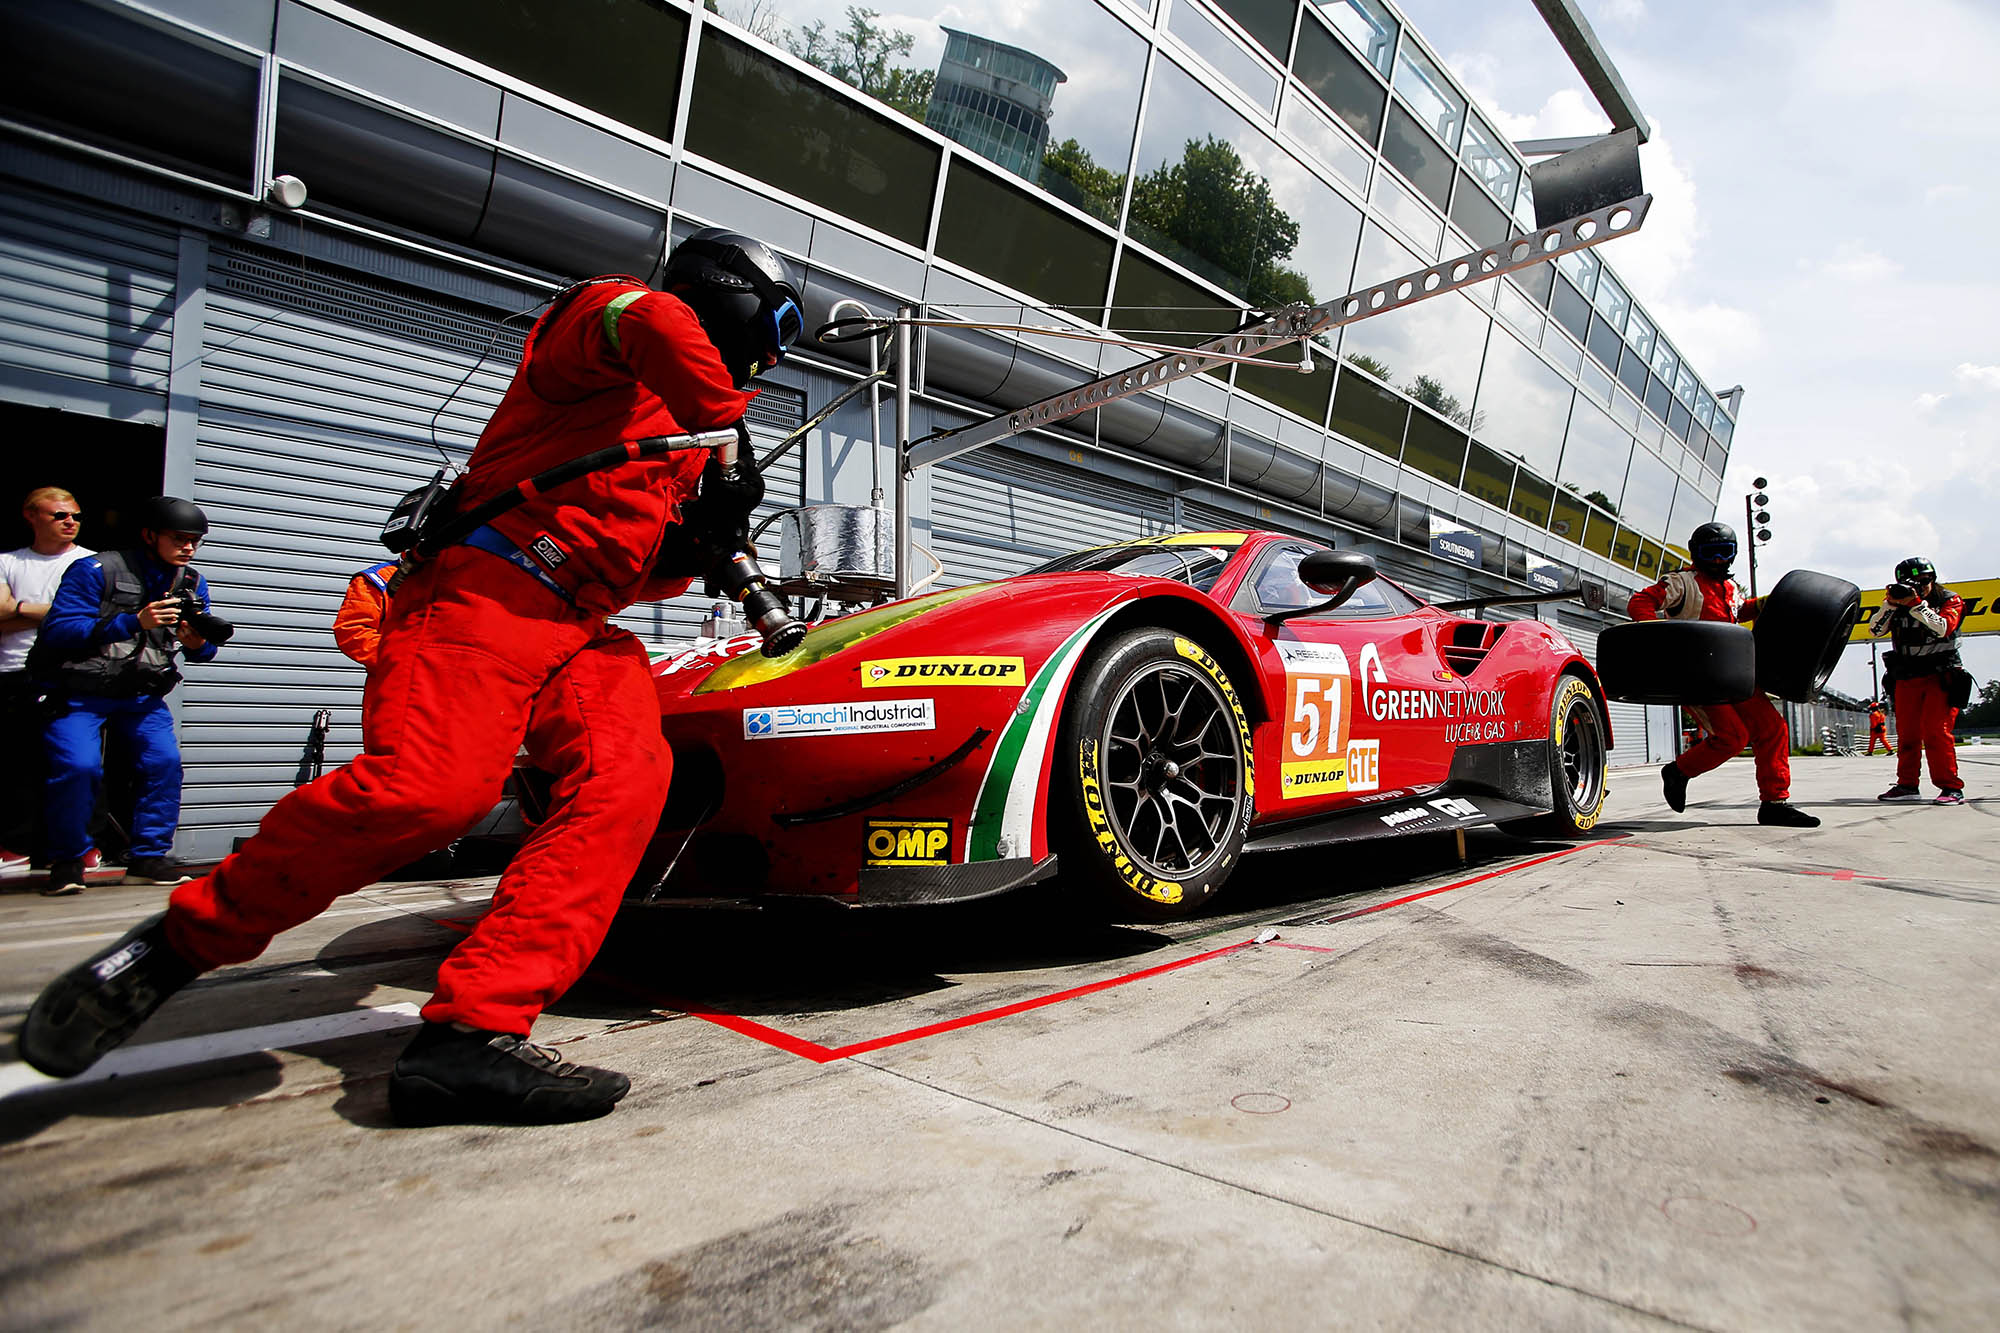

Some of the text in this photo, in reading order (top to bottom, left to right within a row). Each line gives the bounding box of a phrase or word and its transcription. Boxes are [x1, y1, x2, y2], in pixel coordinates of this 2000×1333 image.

[537, 540, 562, 564] OMP
[1440, 538, 1475, 560] SCRUTINEERING
[894, 664, 1016, 678] DUNLOP
[777, 702, 926, 727] Bianchi Industrial
[860, 723, 890, 731] INDUSTRIAL
[890, 721, 926, 729] COMPONENTS
[1291, 678, 1342, 757] 51
[1445, 721, 1505, 742] LUCE & GAS
[1348, 747, 1378, 784] GTE
[1293, 770, 1344, 786] DUNLOP
[868, 829, 948, 857] OMP
